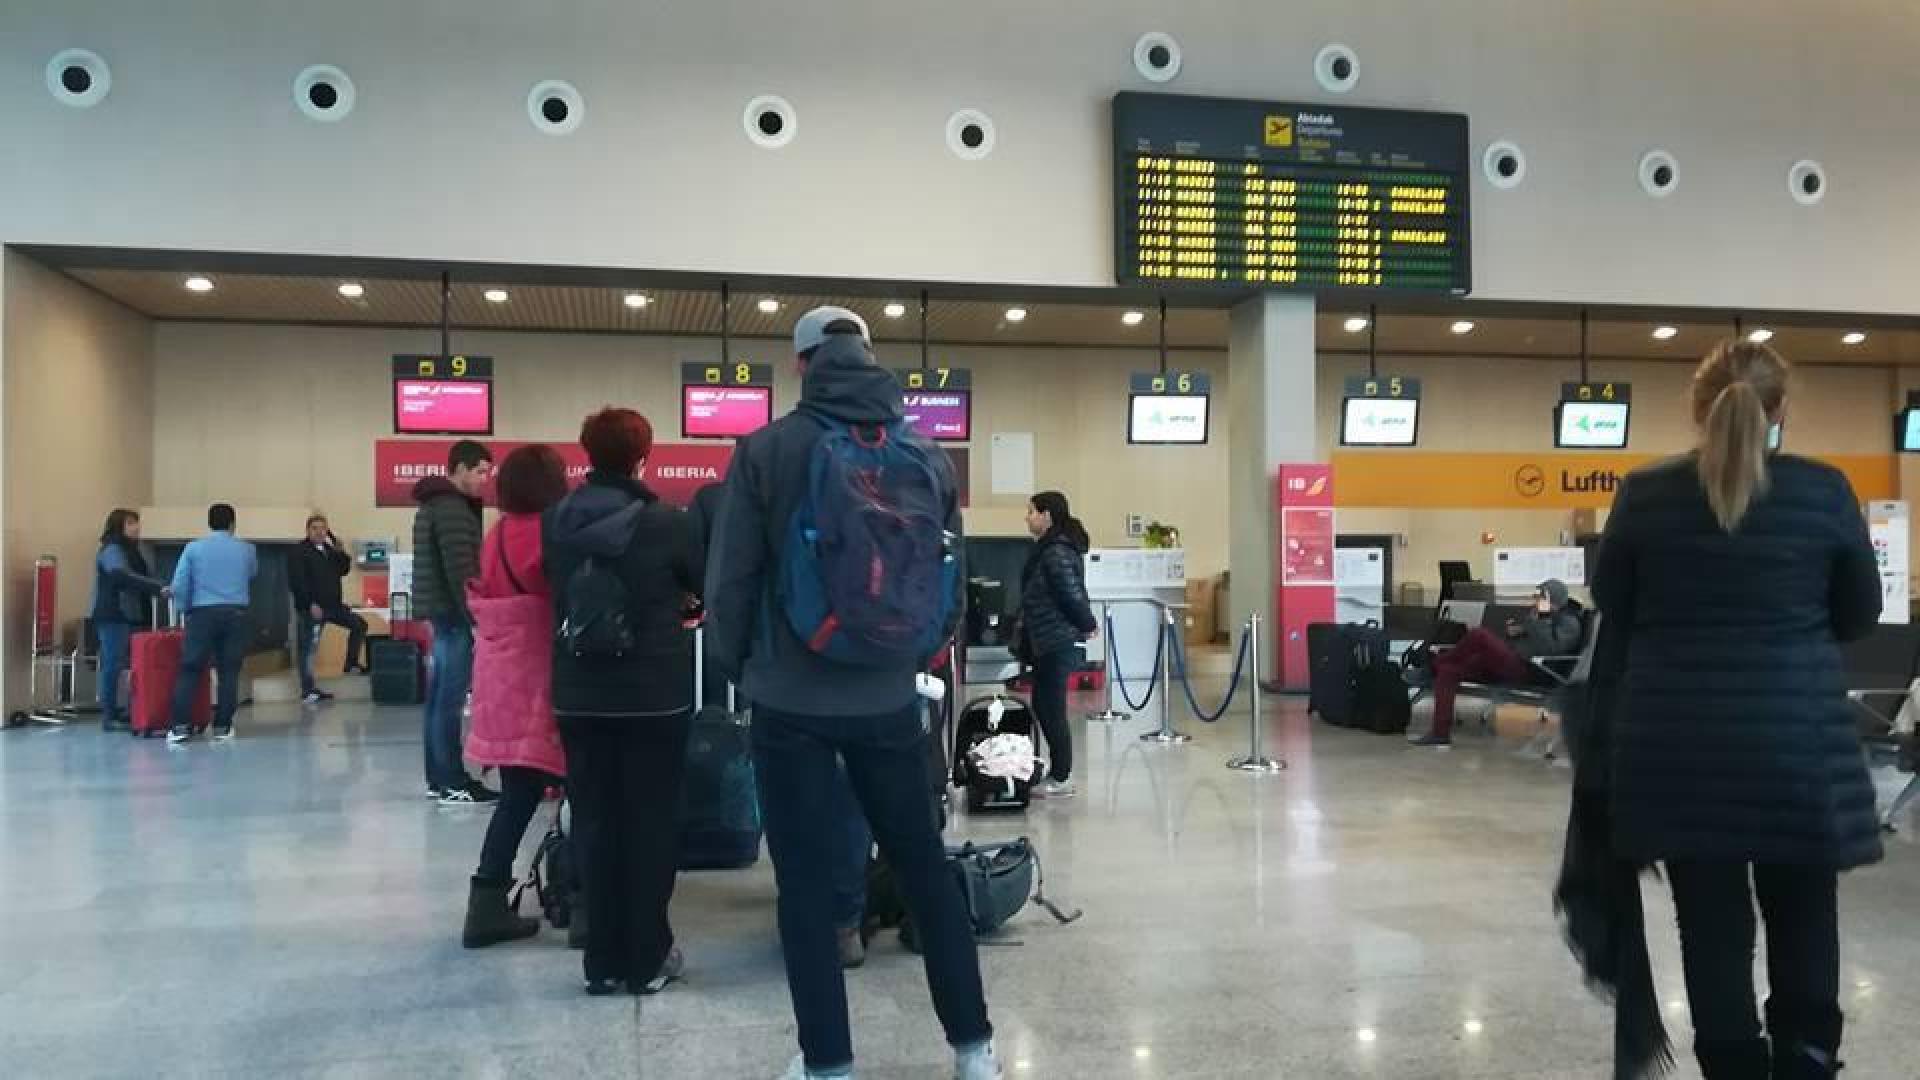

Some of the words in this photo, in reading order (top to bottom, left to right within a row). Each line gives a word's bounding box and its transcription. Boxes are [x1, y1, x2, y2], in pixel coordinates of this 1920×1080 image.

[451, 355, 467, 377] 9
[735, 362, 751, 385] 8
[937, 367, 949, 389] 7
[1177, 373, 1191, 393] 6
[1391, 377, 1402, 396] 5
[1601, 383, 1614, 401] 4
[393, 463, 448, 477] IBERI
[656, 465, 718, 480] IBERIA
